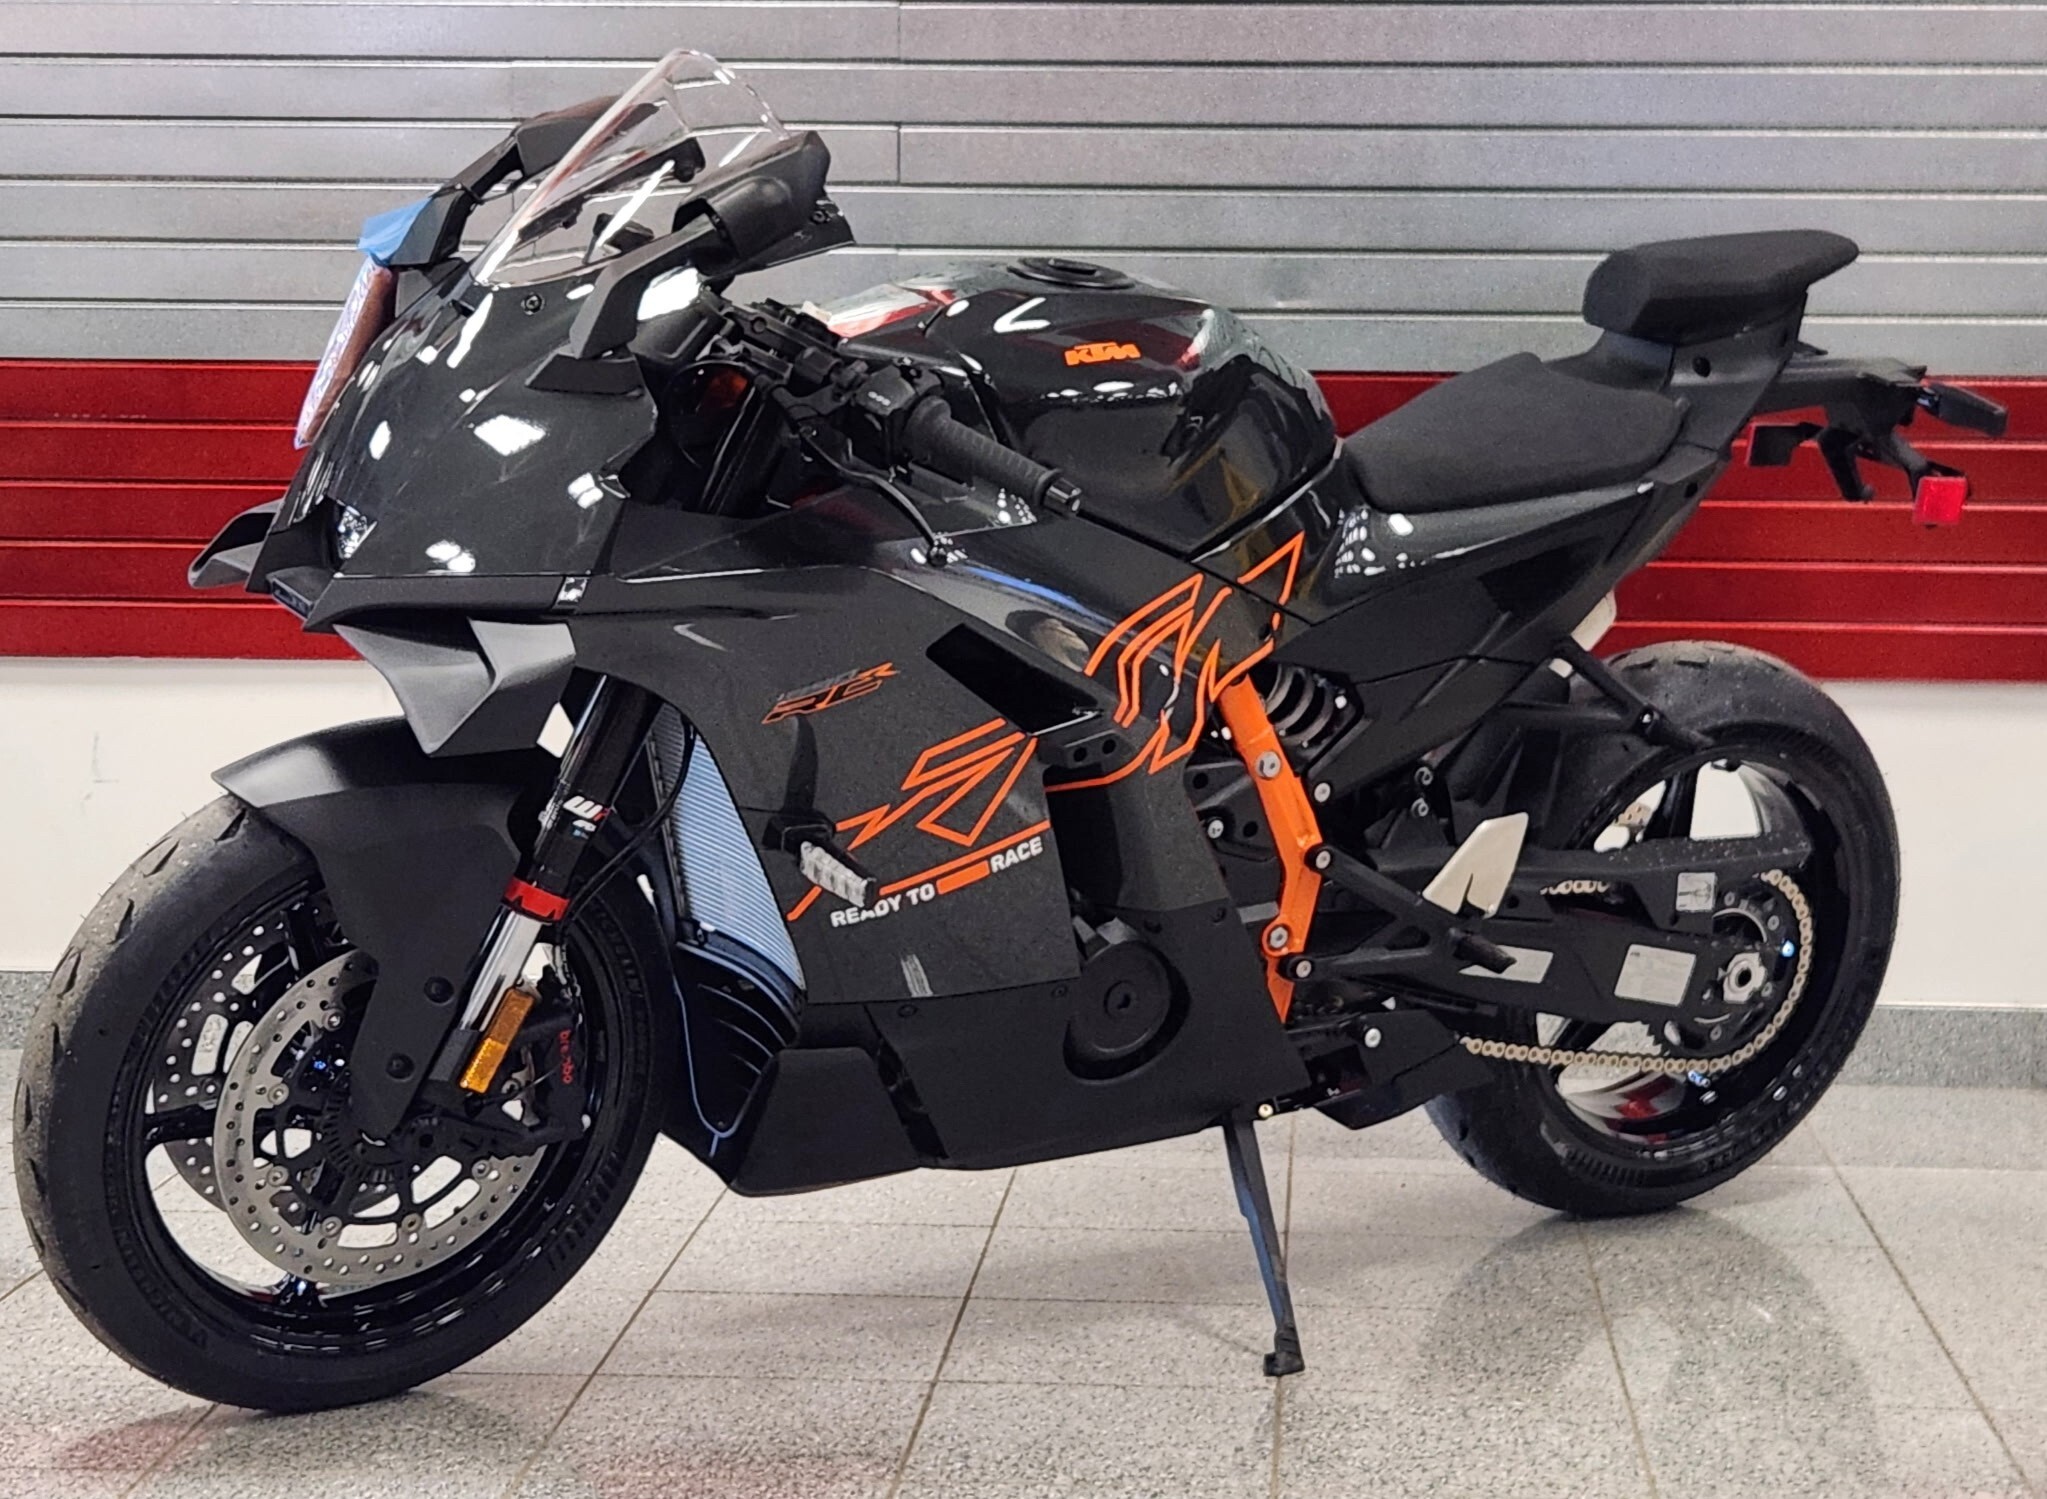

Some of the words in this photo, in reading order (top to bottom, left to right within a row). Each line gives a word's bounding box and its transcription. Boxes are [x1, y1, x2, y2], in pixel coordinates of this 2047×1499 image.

[1064, 341, 1141, 366] KTM
[830, 894, 902, 928] READY
[906, 882, 935, 905] TO
[990, 836, 1043, 873] RACE
